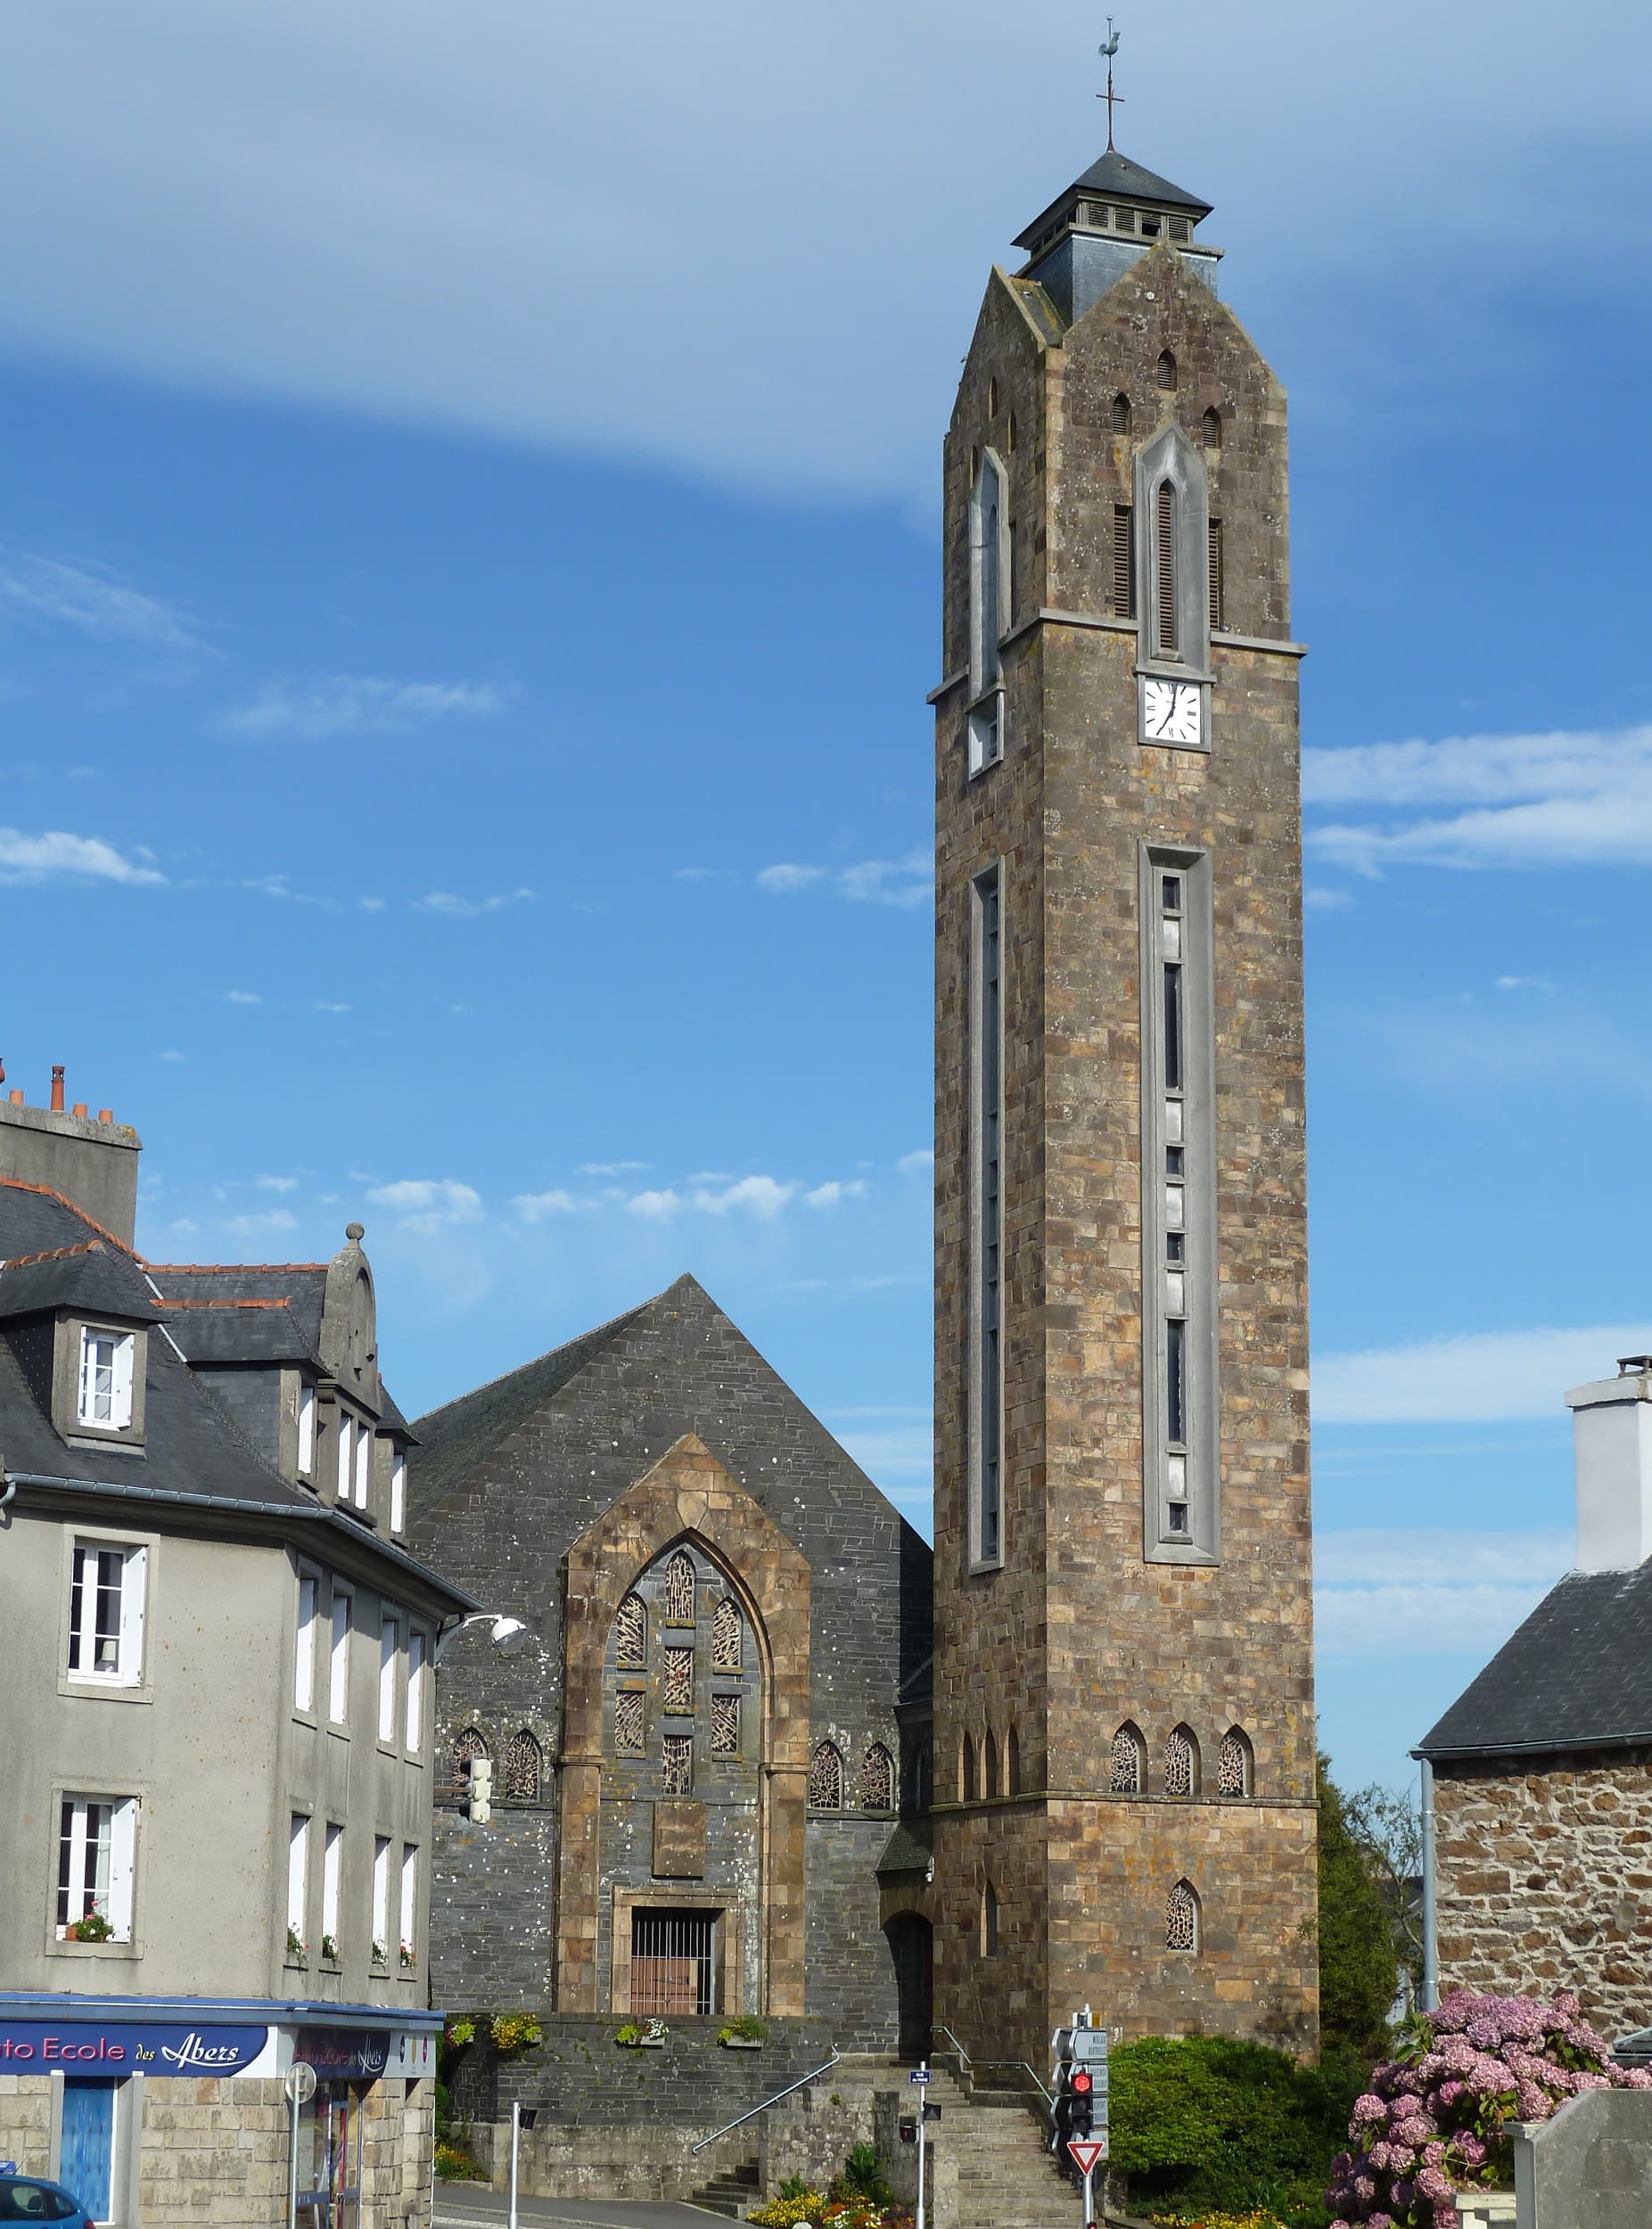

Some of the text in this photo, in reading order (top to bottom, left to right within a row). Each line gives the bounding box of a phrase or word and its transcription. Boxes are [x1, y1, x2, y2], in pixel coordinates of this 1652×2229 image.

[0, 2032, 247, 2069] to Ecole des Abers
[358, 2033, 384, 2076] Abers
